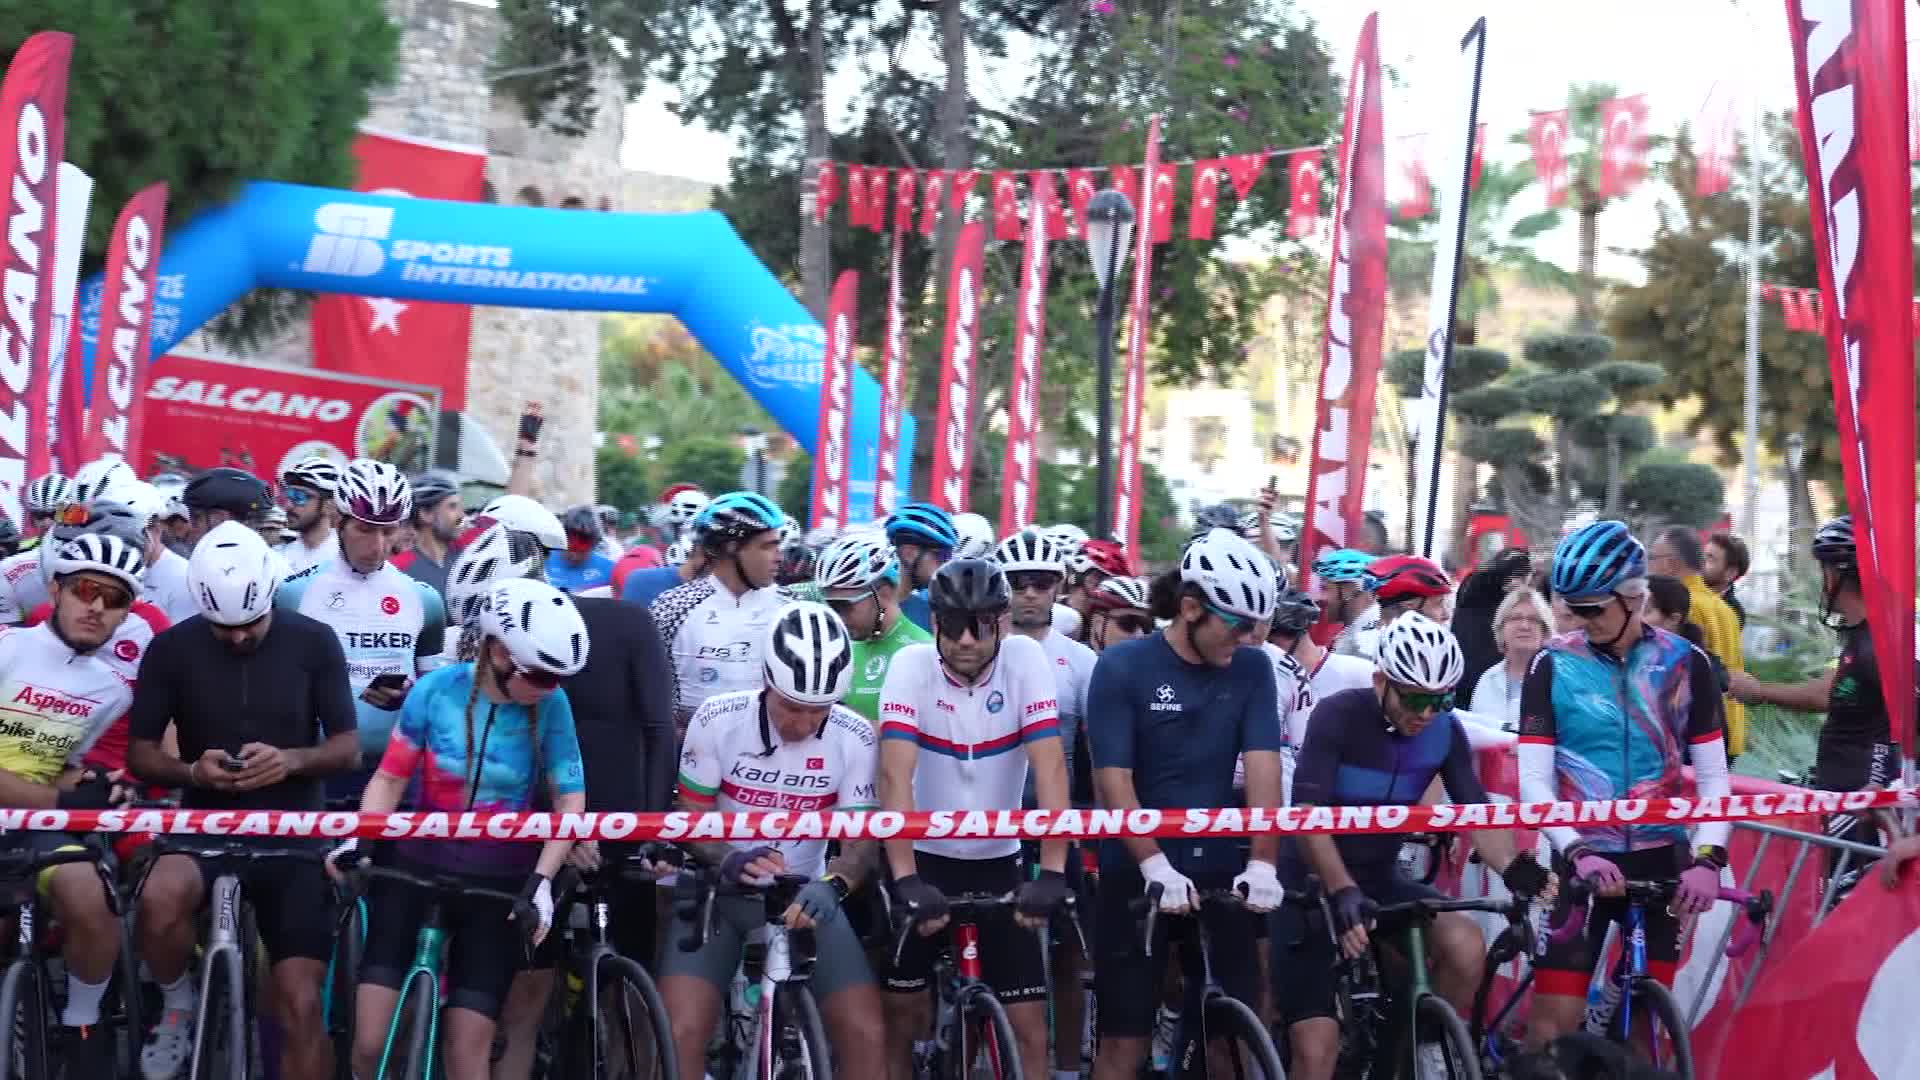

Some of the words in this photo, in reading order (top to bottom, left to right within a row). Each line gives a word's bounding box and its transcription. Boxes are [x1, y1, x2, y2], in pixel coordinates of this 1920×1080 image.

[391, 239, 512, 268] SPORTS
[402, 261, 647, 295] INTERNATIONAL
[148, 376, 352, 421] SALCANO
[346, 632, 412, 648] TEKER
[12, 685, 92, 717] Asperox
[95, 809, 360, 836] SALCANO
[381, 811, 638, 839] SALCANO
[657, 811, 905, 838] SALCANO
[925, 809, 1162, 837] SALCANO
[1181, 805, 1408, 833] SALCANO
[1428, 799, 1648, 827] SALCANO
[1665, 790, 1877, 819] SALCANO
